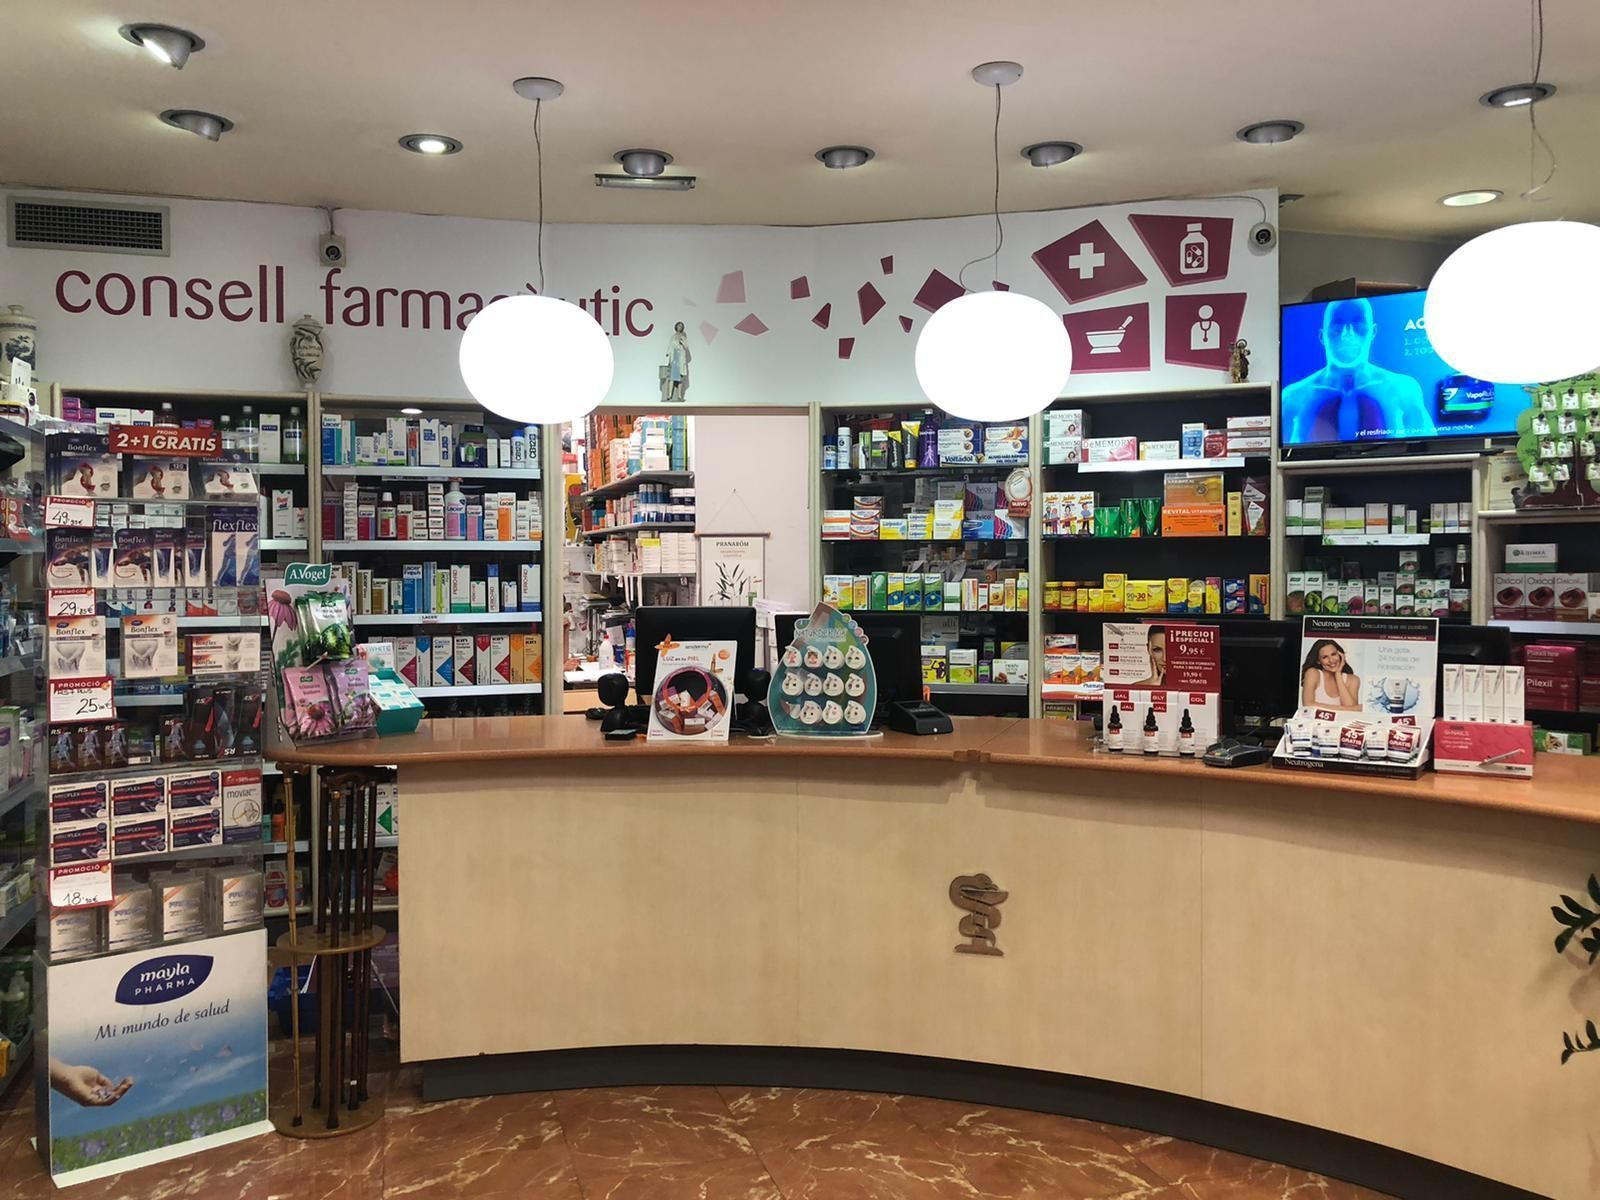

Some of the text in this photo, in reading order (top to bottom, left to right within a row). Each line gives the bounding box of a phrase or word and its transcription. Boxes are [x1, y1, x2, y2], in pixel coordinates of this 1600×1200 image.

[55, 264, 655, 338] consell farmatic
[117, 433, 217, 452] 2+1 GRATIS
[67, 443, 97, 453] Bonflex
[529, 440, 537, 459] CB12
[944, 455, 974, 463] Voltadol
[118, 535, 146, 544] Bonflex
[289, 568, 327, 583] A.Vogel
[1312, 619, 1351, 629] Neutrogena
[55, 628, 87, 636] Bonflex
[130, 626, 158, 634] Bonflex
[57, 680, 101, 689] PROMOCIÓ
[1526, 678, 1553, 688] Pilexil
[1284, 757, 1324, 769] Neutrogena
[57, 864, 101, 875] PROMOCIÓ
[134, 977, 197, 997] PHARMA
[95, 997, 231, 1041] Mi mundo de salud
